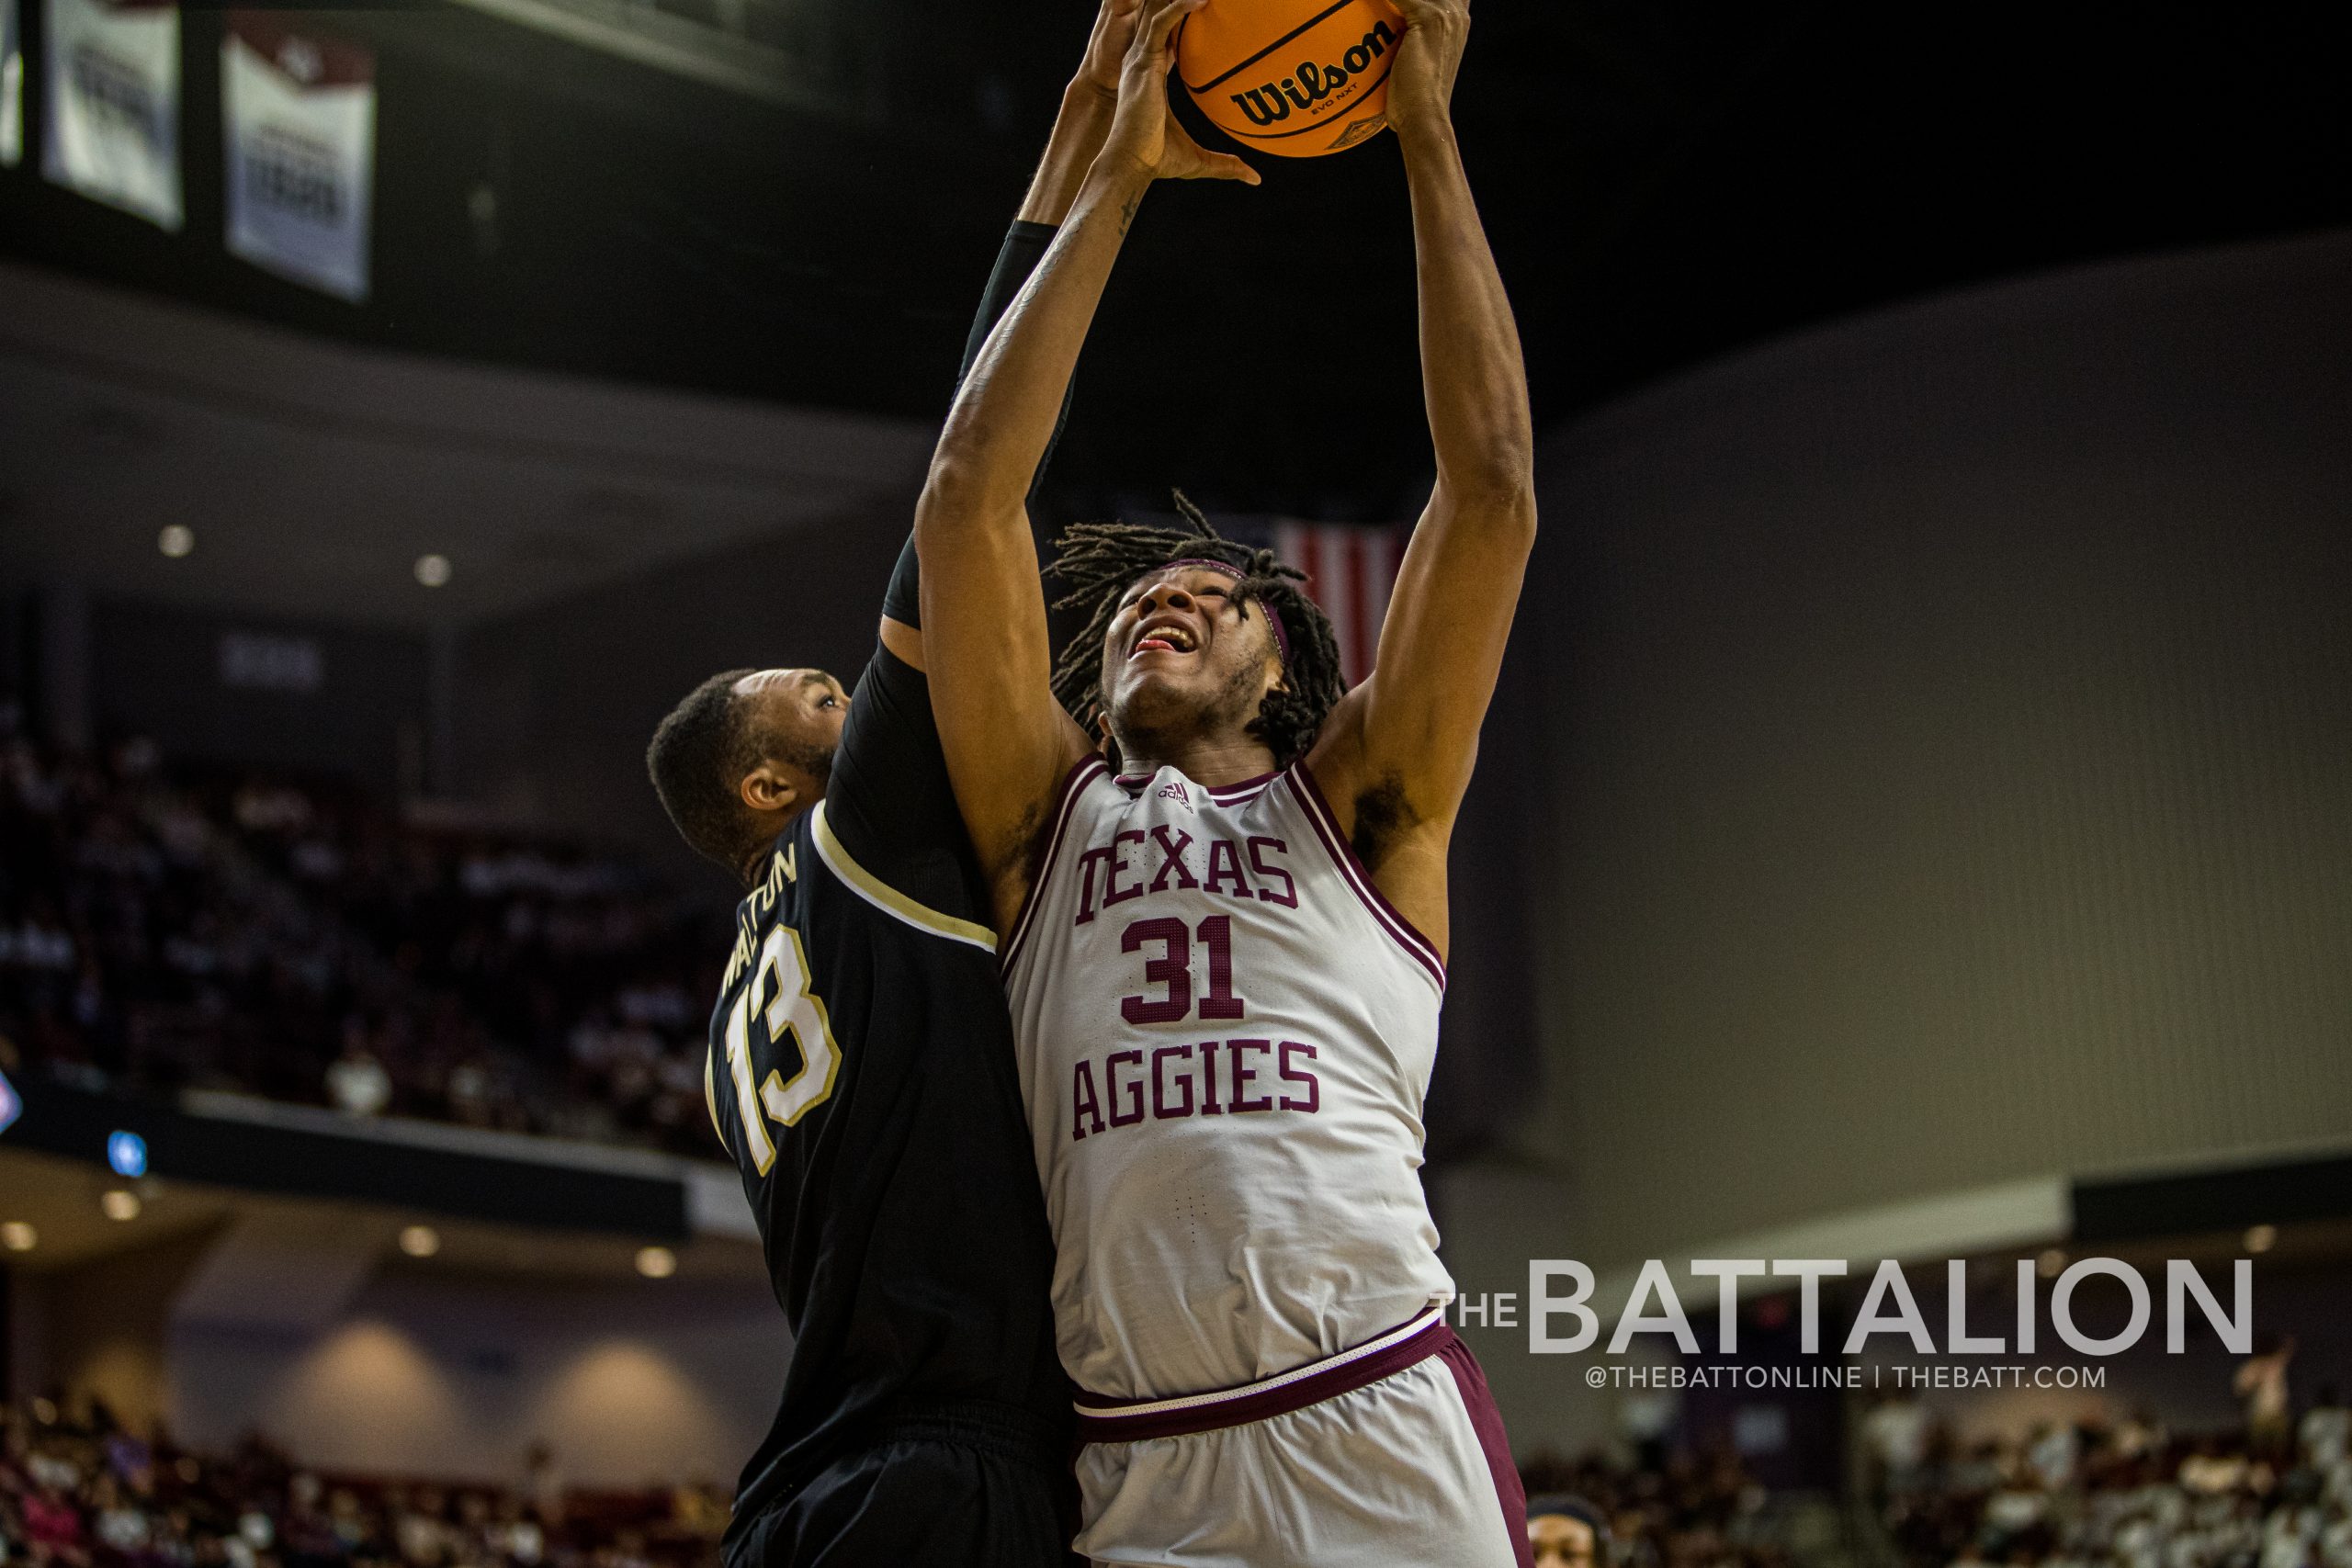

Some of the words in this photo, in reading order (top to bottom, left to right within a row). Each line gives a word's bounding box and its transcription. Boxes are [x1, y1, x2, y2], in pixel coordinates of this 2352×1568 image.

[1231, 20, 1397, 126] Wilson
[1311, 99, 1334, 115] EVO
[1336, 83, 1358, 100] NXT
[1159, 790, 1193, 814] adidas
[1075, 825, 1299, 926] TEXAS
[1121, 915, 1244, 1025] 31
[726, 923, 842, 1177] 13
[1072, 1039, 1320, 1141] AGGIES
